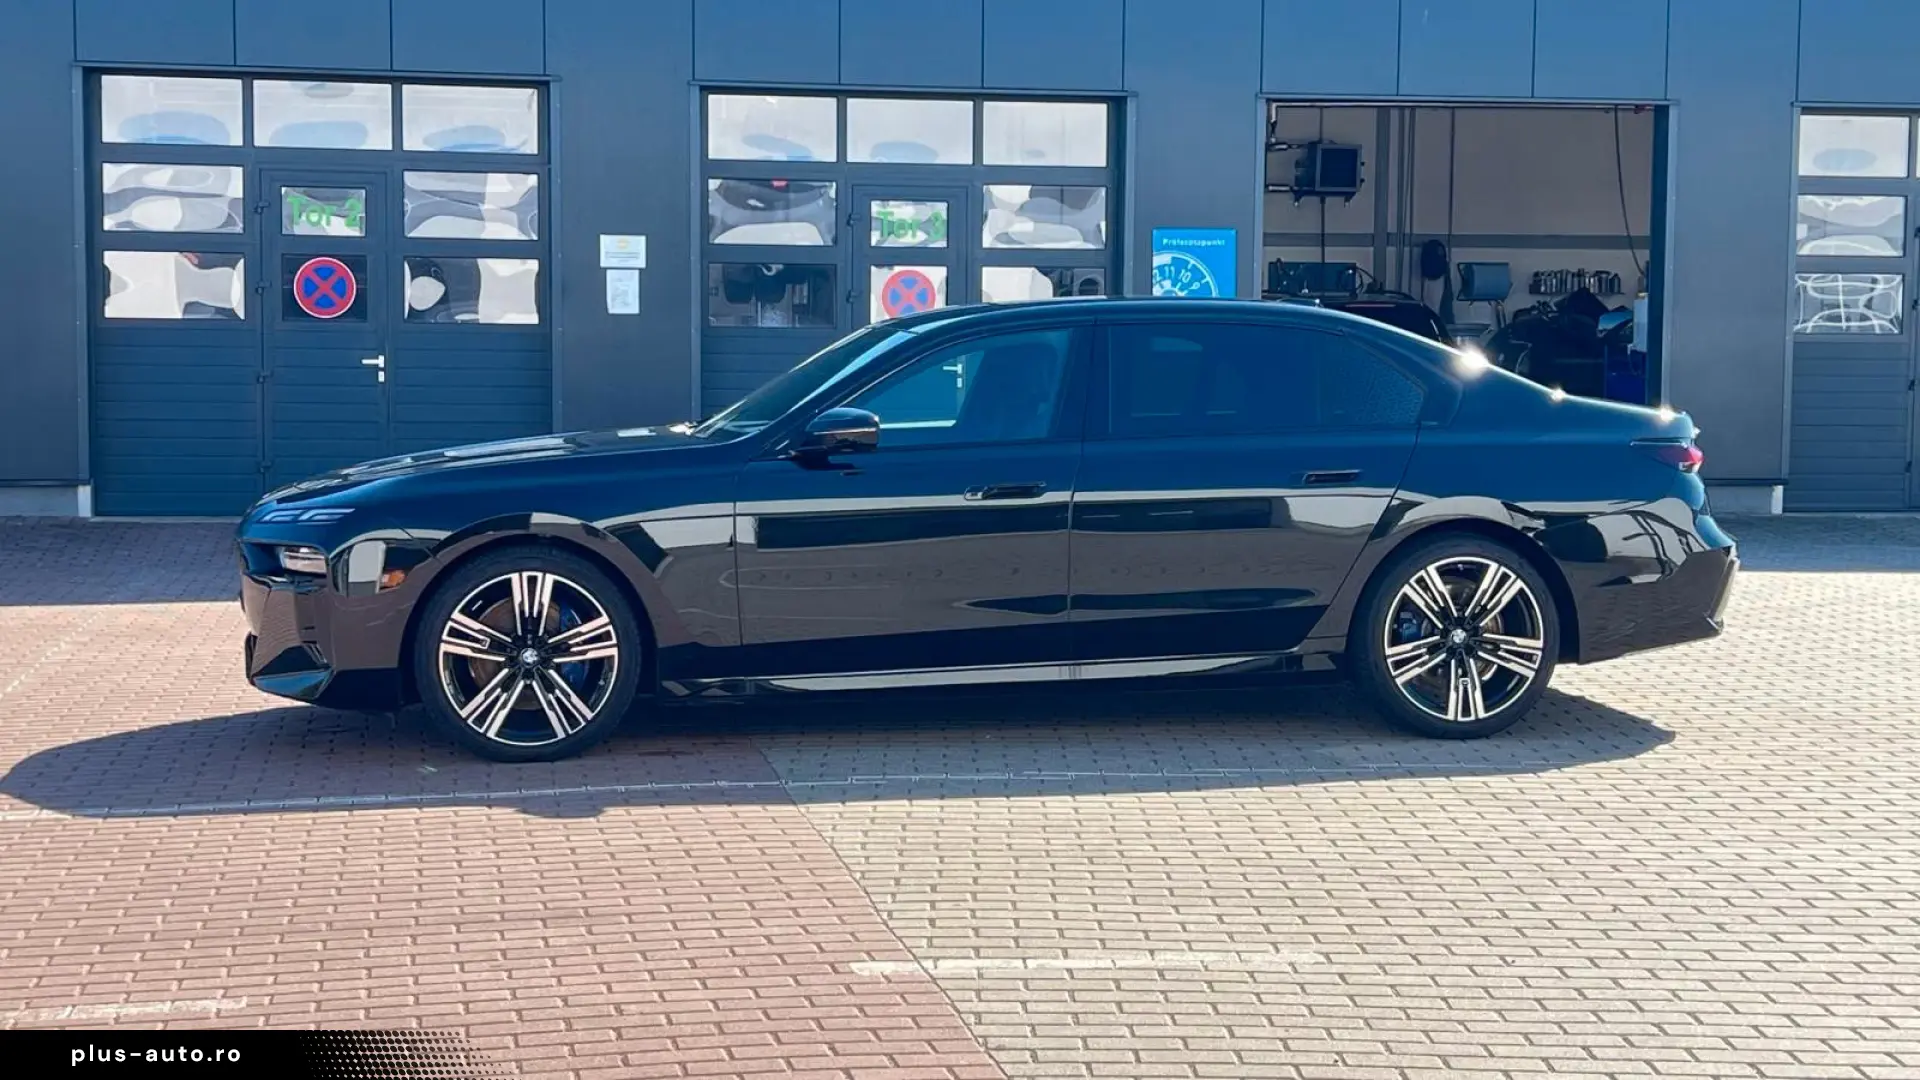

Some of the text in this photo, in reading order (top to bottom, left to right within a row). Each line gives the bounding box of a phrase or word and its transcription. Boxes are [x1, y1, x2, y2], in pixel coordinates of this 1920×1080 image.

[287, 195, 361, 228] Tor 2
[875, 210, 946, 241] Tor 3
[1164, 266, 1176, 279] 11
[1178, 269, 1192, 283] 10
[1188, 281, 1201, 290] 9
